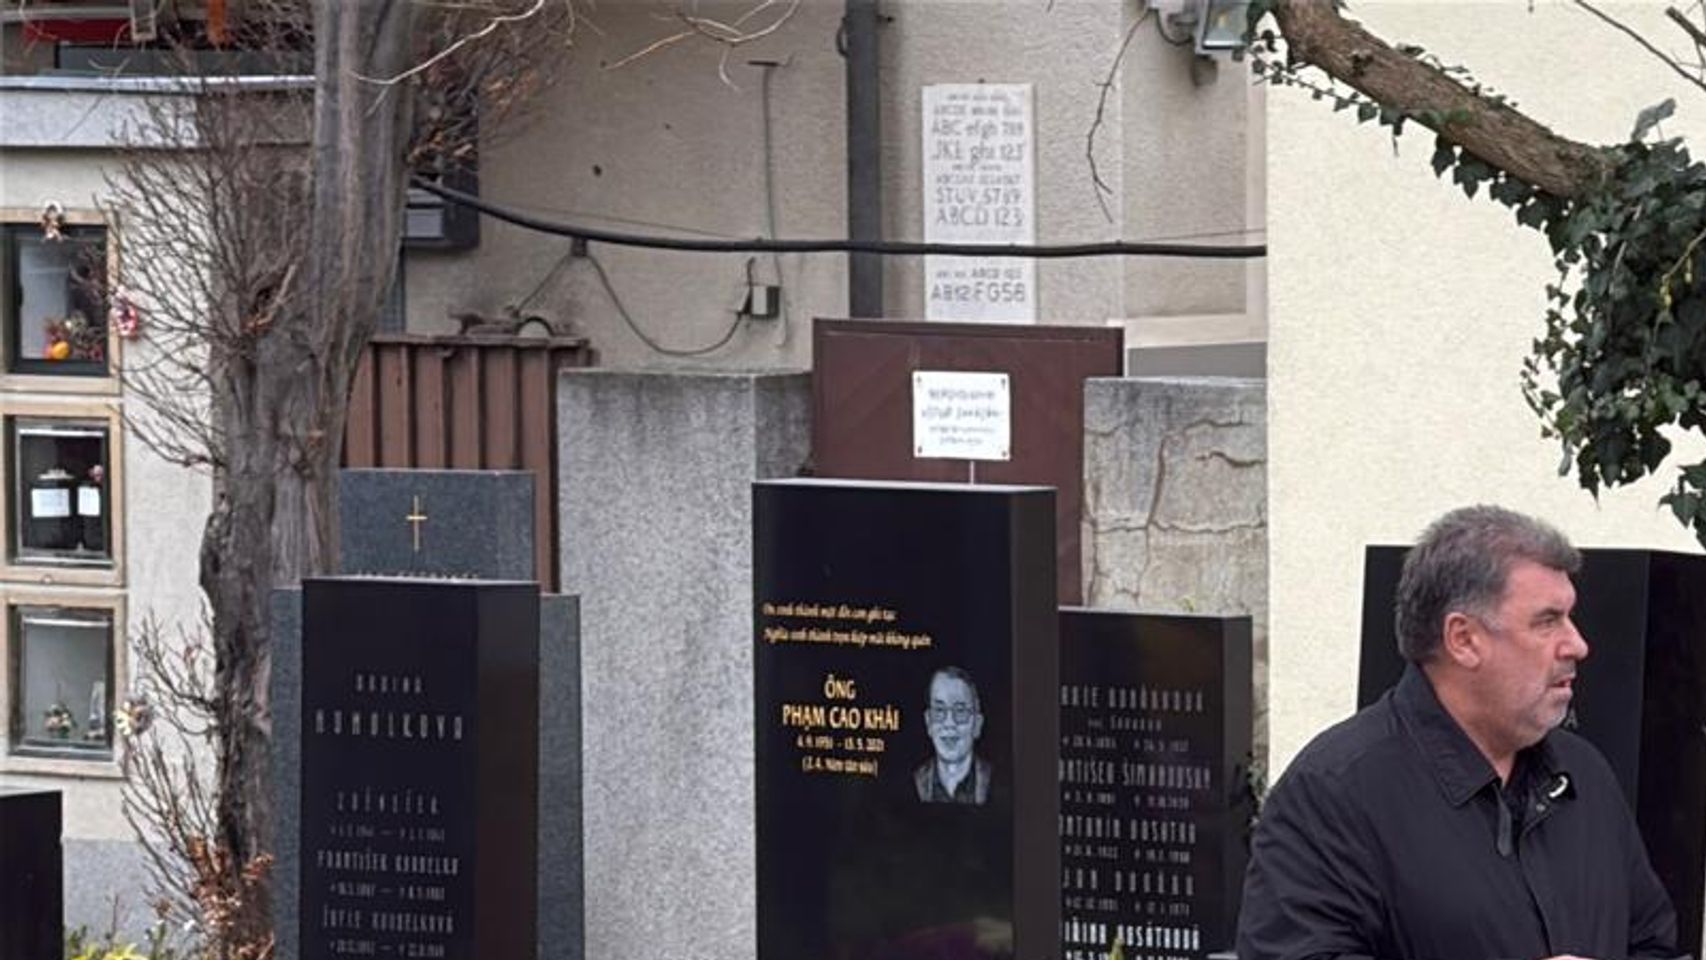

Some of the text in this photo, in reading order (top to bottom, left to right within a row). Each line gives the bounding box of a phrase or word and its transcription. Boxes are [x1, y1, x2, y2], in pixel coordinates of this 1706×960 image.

[935, 205, 1025, 227] ABCD 123
[1061, 684, 1102, 709] ARIE
[783, 704, 826, 732] PHẠM
[829, 706, 862, 730] CAO
